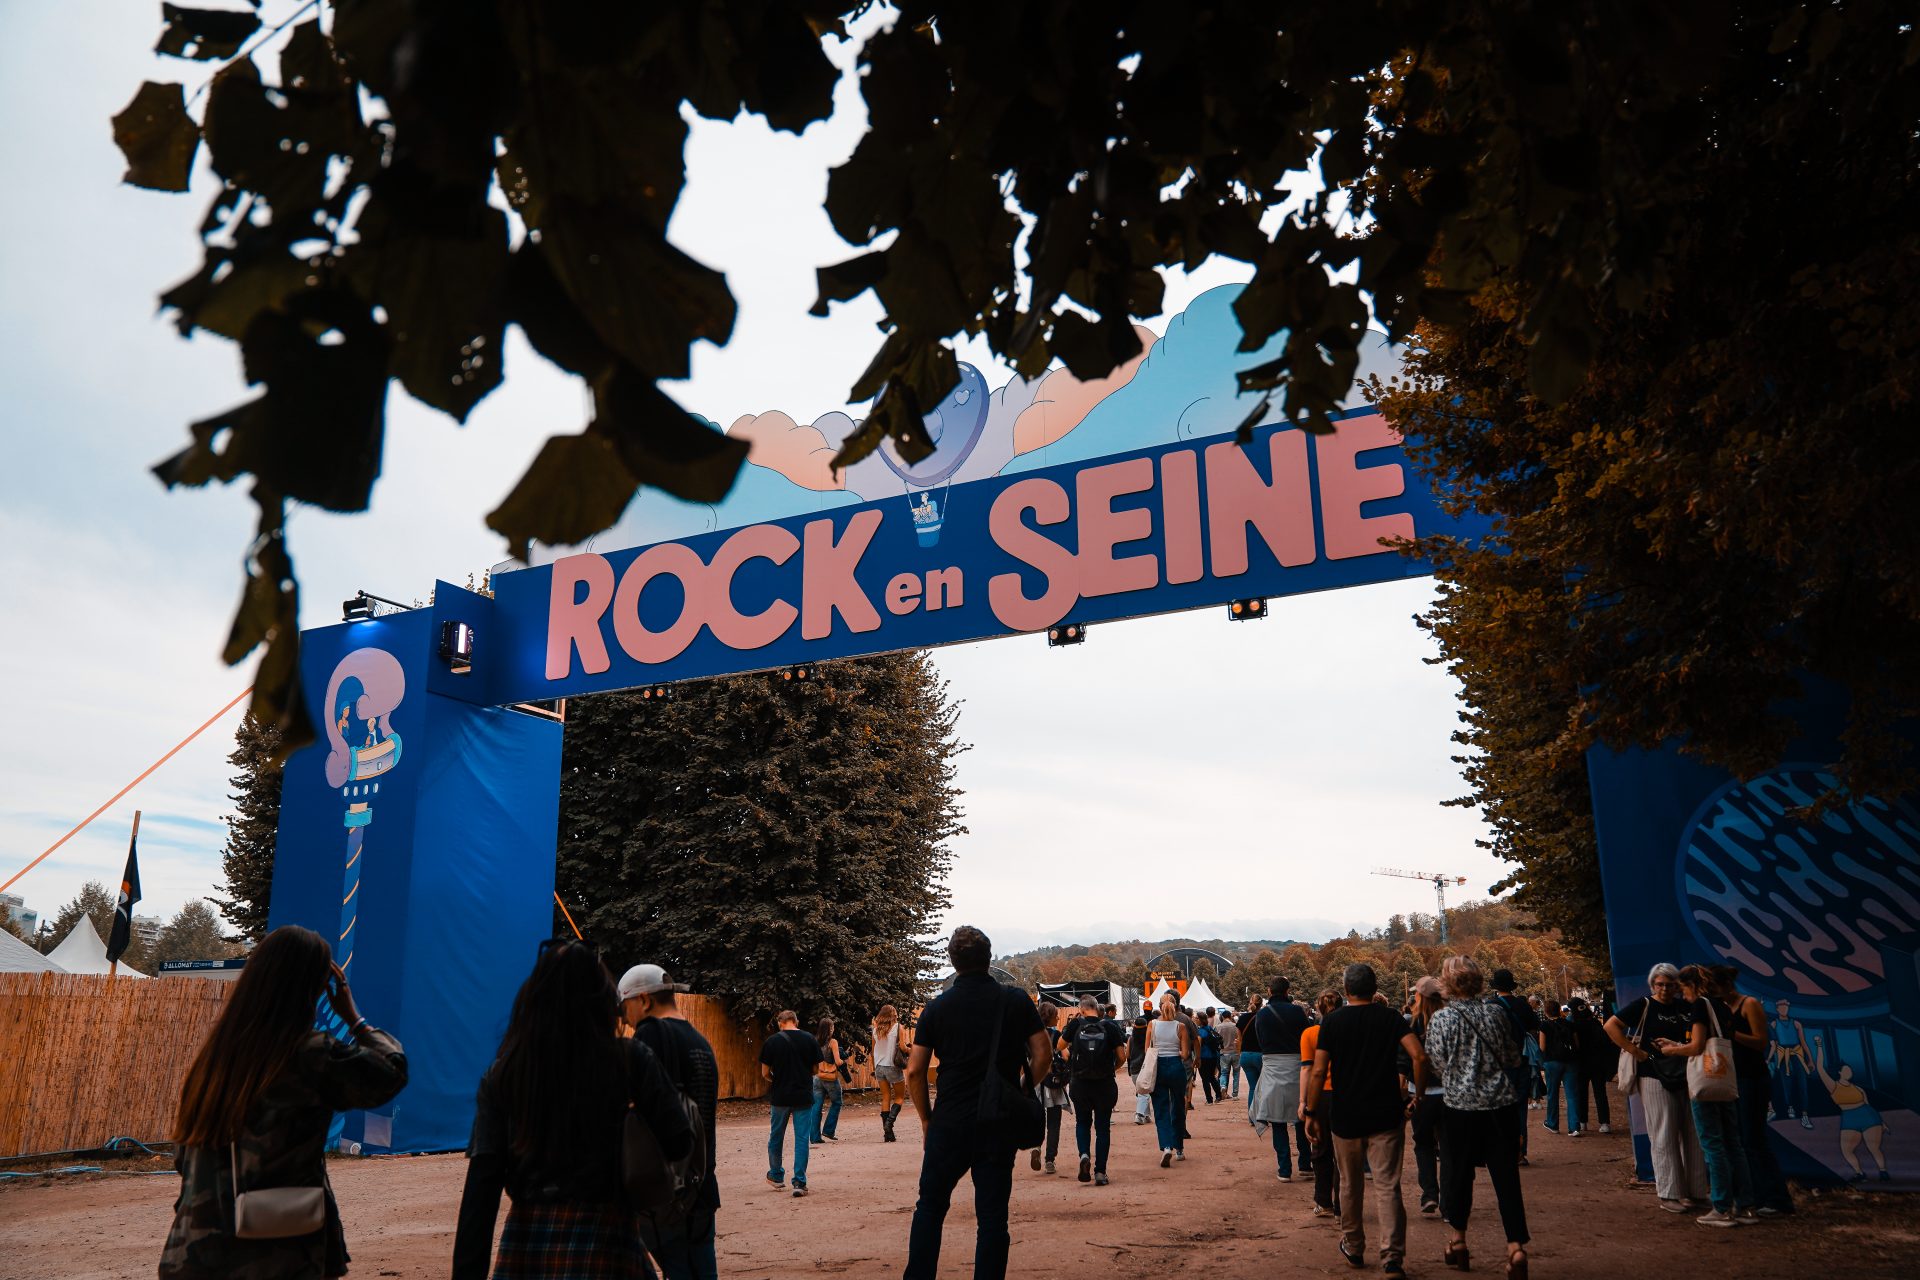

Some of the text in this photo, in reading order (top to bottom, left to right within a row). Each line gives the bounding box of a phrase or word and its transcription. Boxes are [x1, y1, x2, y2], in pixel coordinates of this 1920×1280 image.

[545, 413, 1416, 681] ROCK en SEINE
